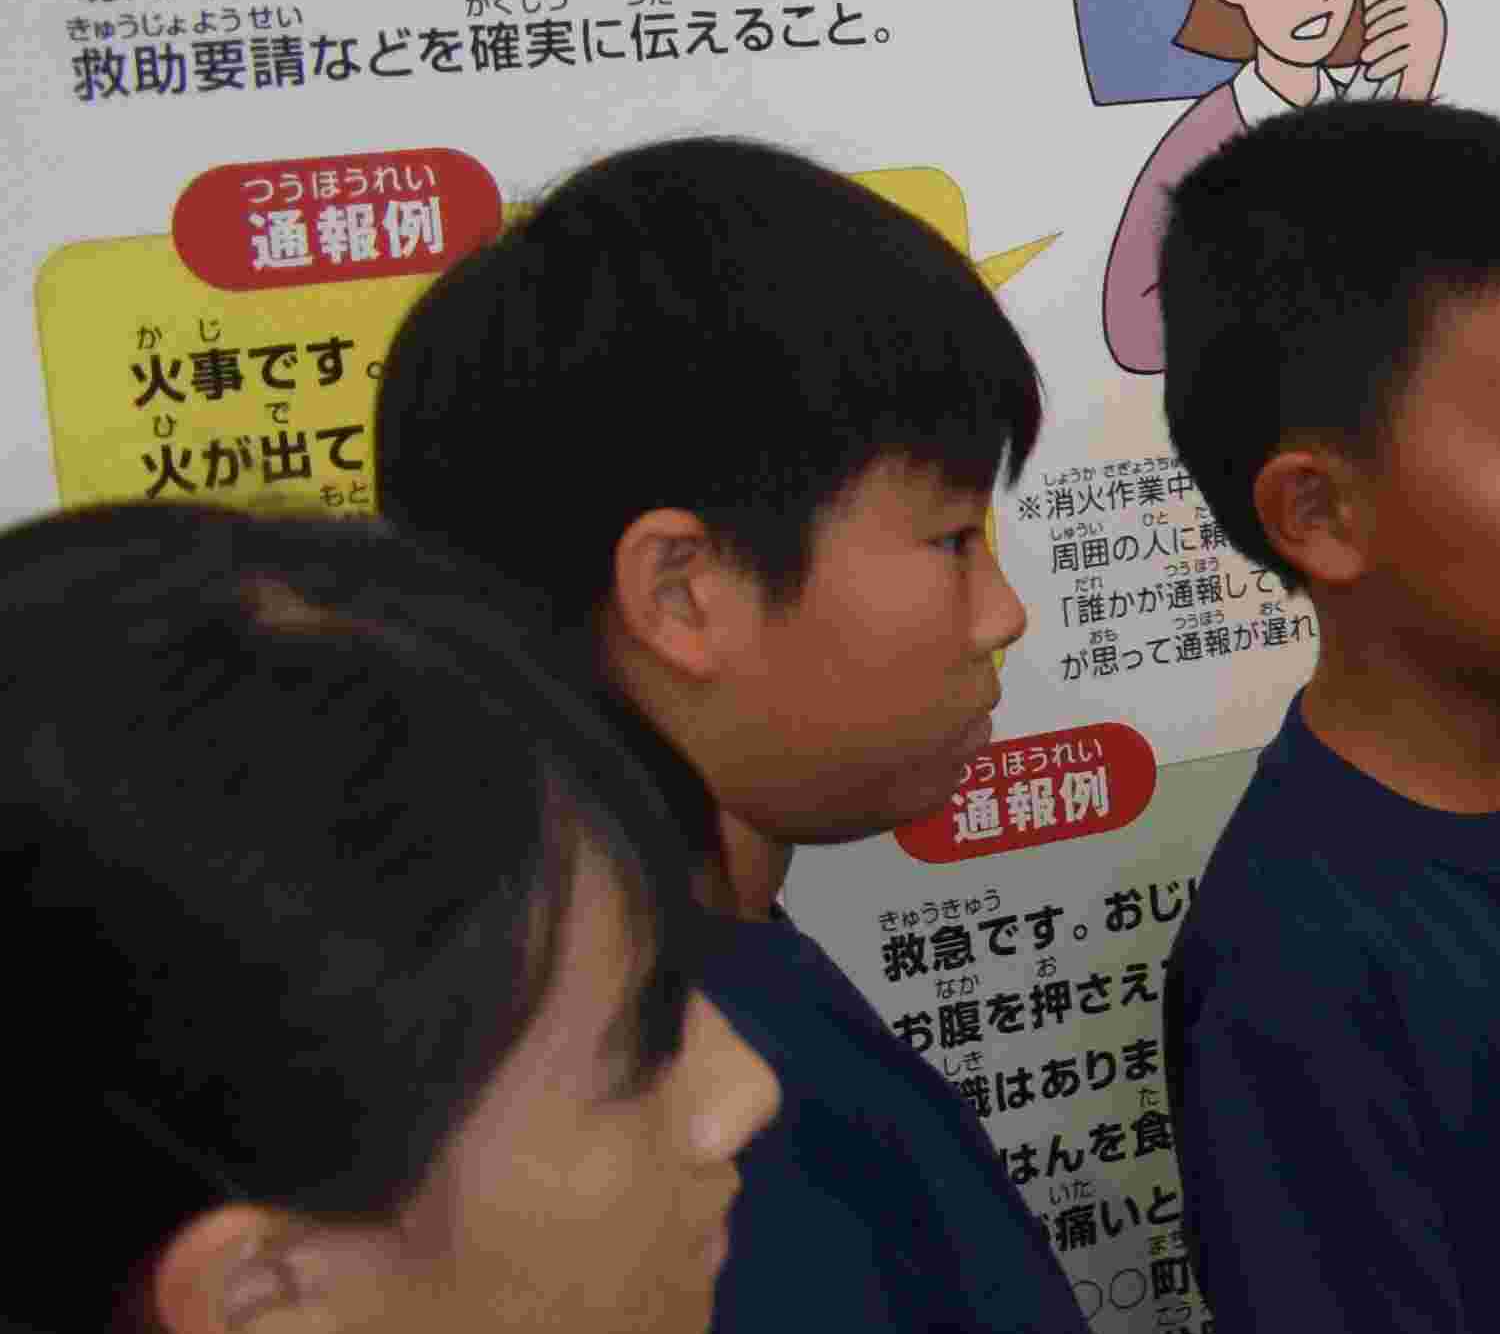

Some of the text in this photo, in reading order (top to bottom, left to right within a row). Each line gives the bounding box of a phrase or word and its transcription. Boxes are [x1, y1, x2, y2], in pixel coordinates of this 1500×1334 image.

[66, 3, 304, 43] きゅうじょようせい
[71, 0, 893, 102] 救助要請などを確実に伝えること。
[240, 163, 439, 205] つうほうれい
[248, 195, 445, 272] 通報例
[131, 335, 384, 410] 火事です。
[141, 423, 366, 499] 火が出て
[1017, 473, 1195, 522] ※消火作業中
[1050, 512, 1169, 541] しゅうい ひと
[1060, 568, 1273, 629] 「誰かが通報して
[1074, 558, 1220, 593] だれ つうほう
[1060, 614, 1318, 681] が思って通報が遅れ
[1088, 629, 1118, 645] おも
[1173, 611, 1225, 630] つうほう
[952, 767, 1110, 844] 通報例
[878, 888, 1001, 933] きゅうきゅう
[893, 960, 1168, 1052] お腹を押さえ
[935, 974, 981, 999] なか
[1040, 1185, 1181, 1253] 痛いと
